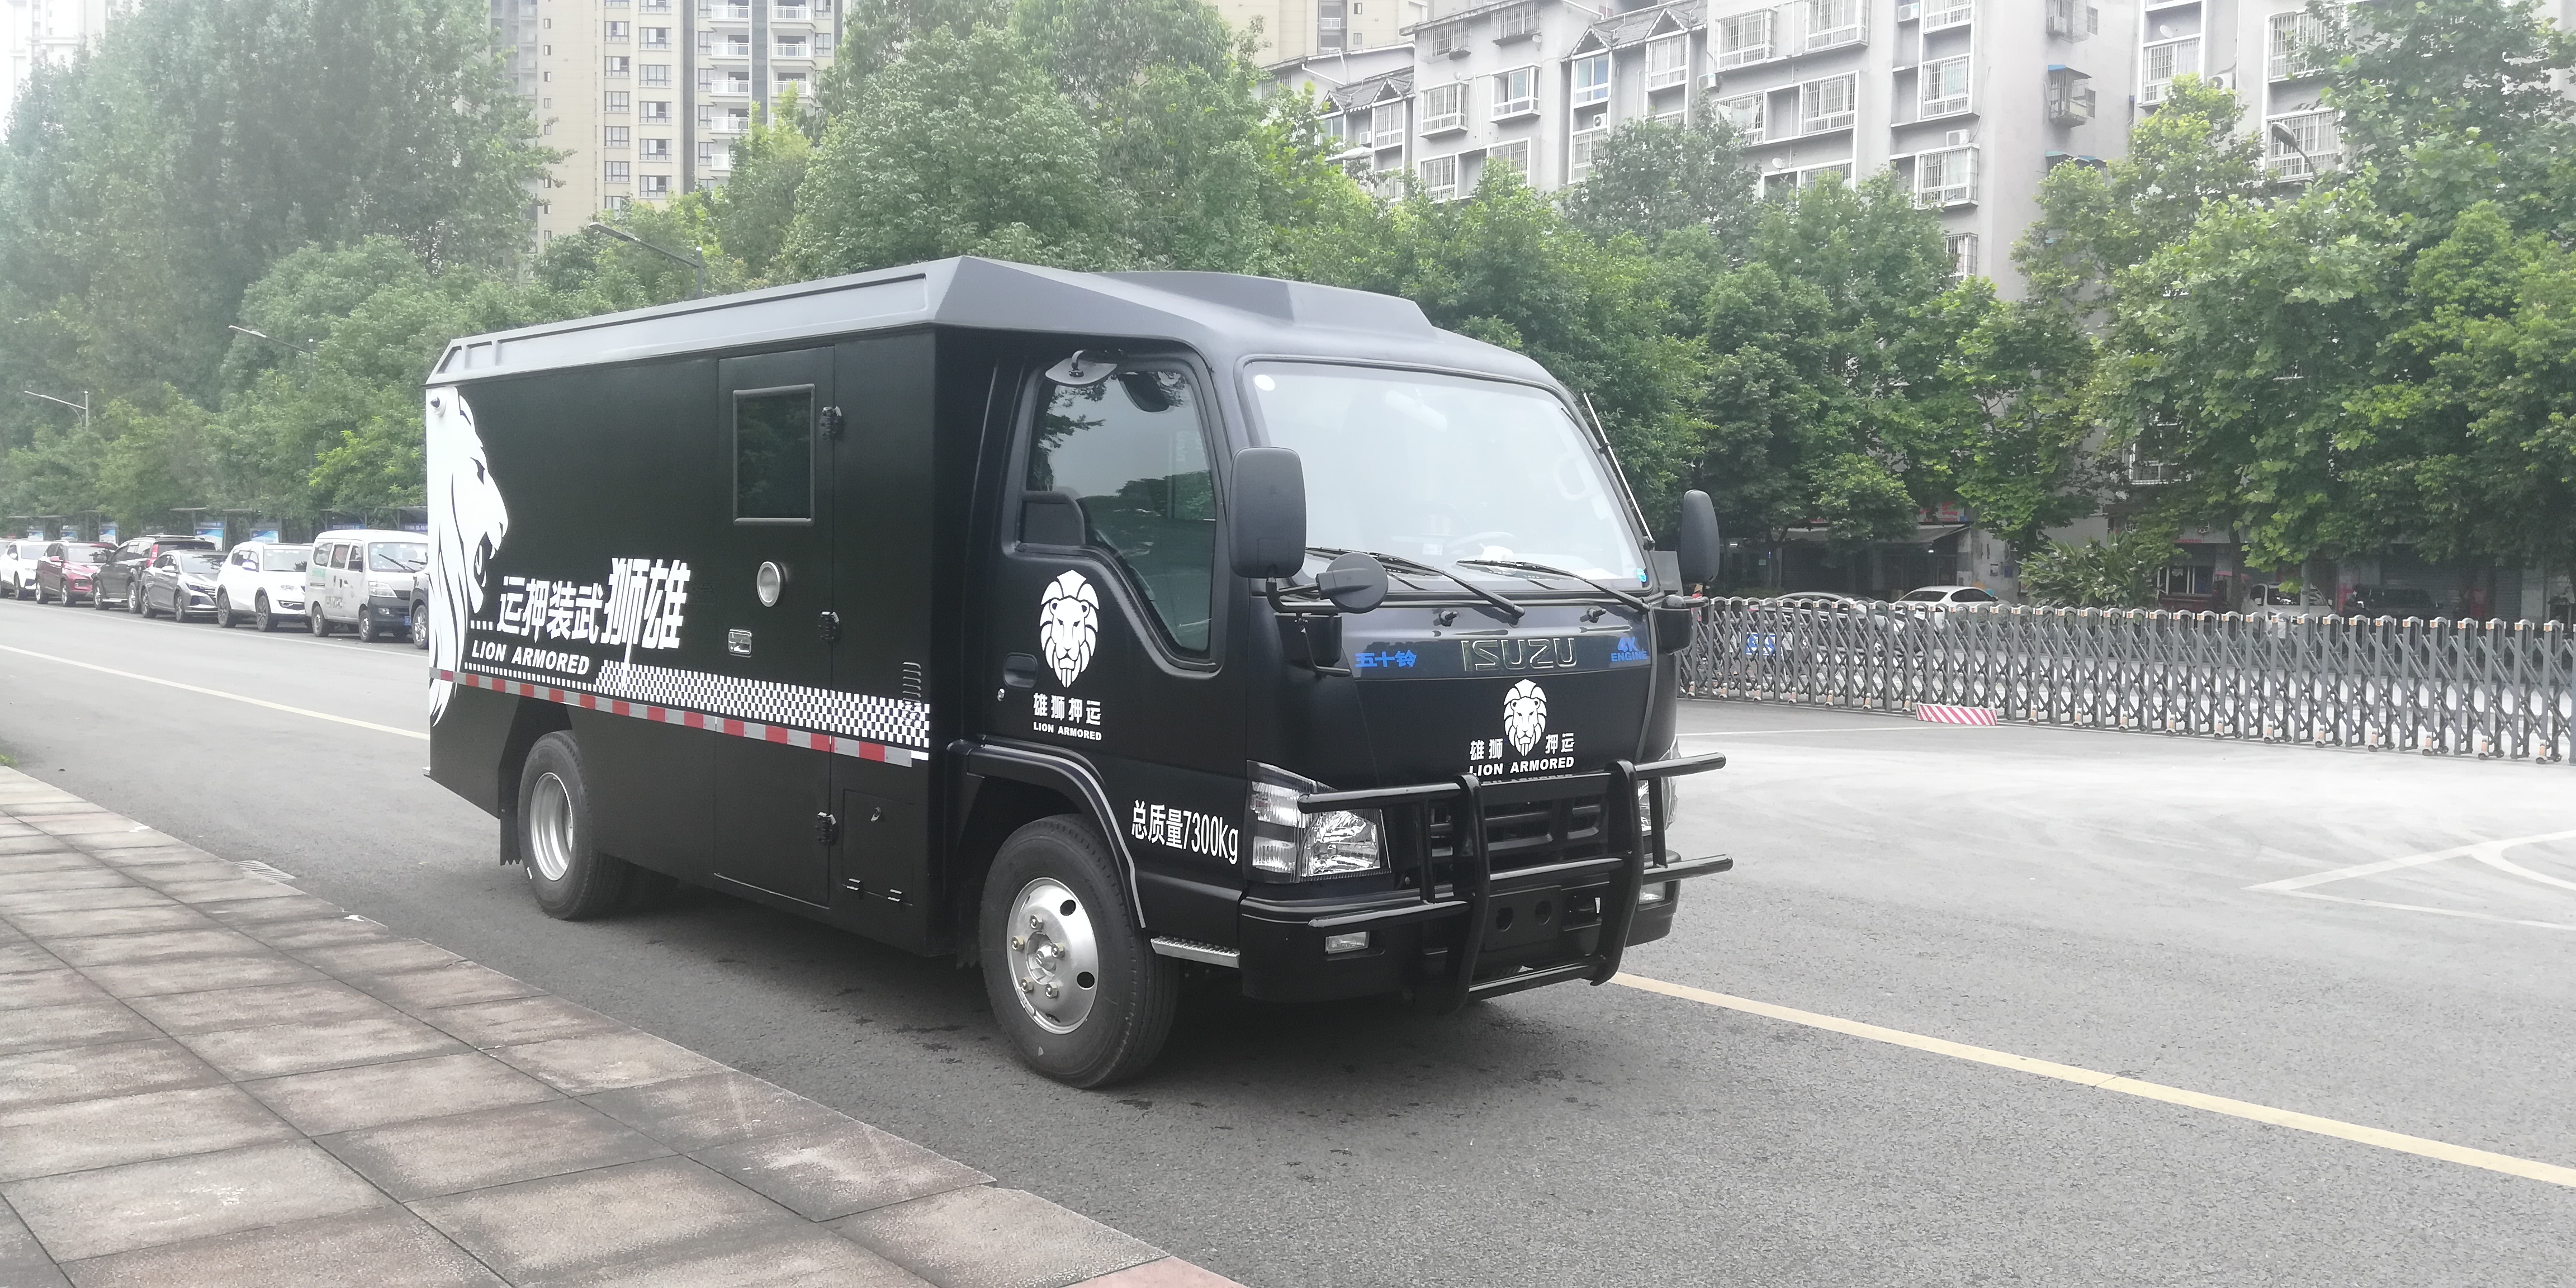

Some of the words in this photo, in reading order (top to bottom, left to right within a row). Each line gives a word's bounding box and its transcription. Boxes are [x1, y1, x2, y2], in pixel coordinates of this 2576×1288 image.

[1617, 636, 1639, 652] 4K
[471, 640, 507, 662] LION
[511, 646, 590, 675] ARMORED
[1355, 649, 1418, 668] 五十铃
[1460, 638, 1578, 672] ISUZU
[1611, 651, 1647, 662] ENGINE
[1033, 692, 1101, 726] 雄狮押运
[1033, 722, 1054, 733] LION
[1057, 726, 1102, 741] ARMORED
[1469, 763, 1503, 776] LION
[1509, 756, 1574, 774] ARMORED
